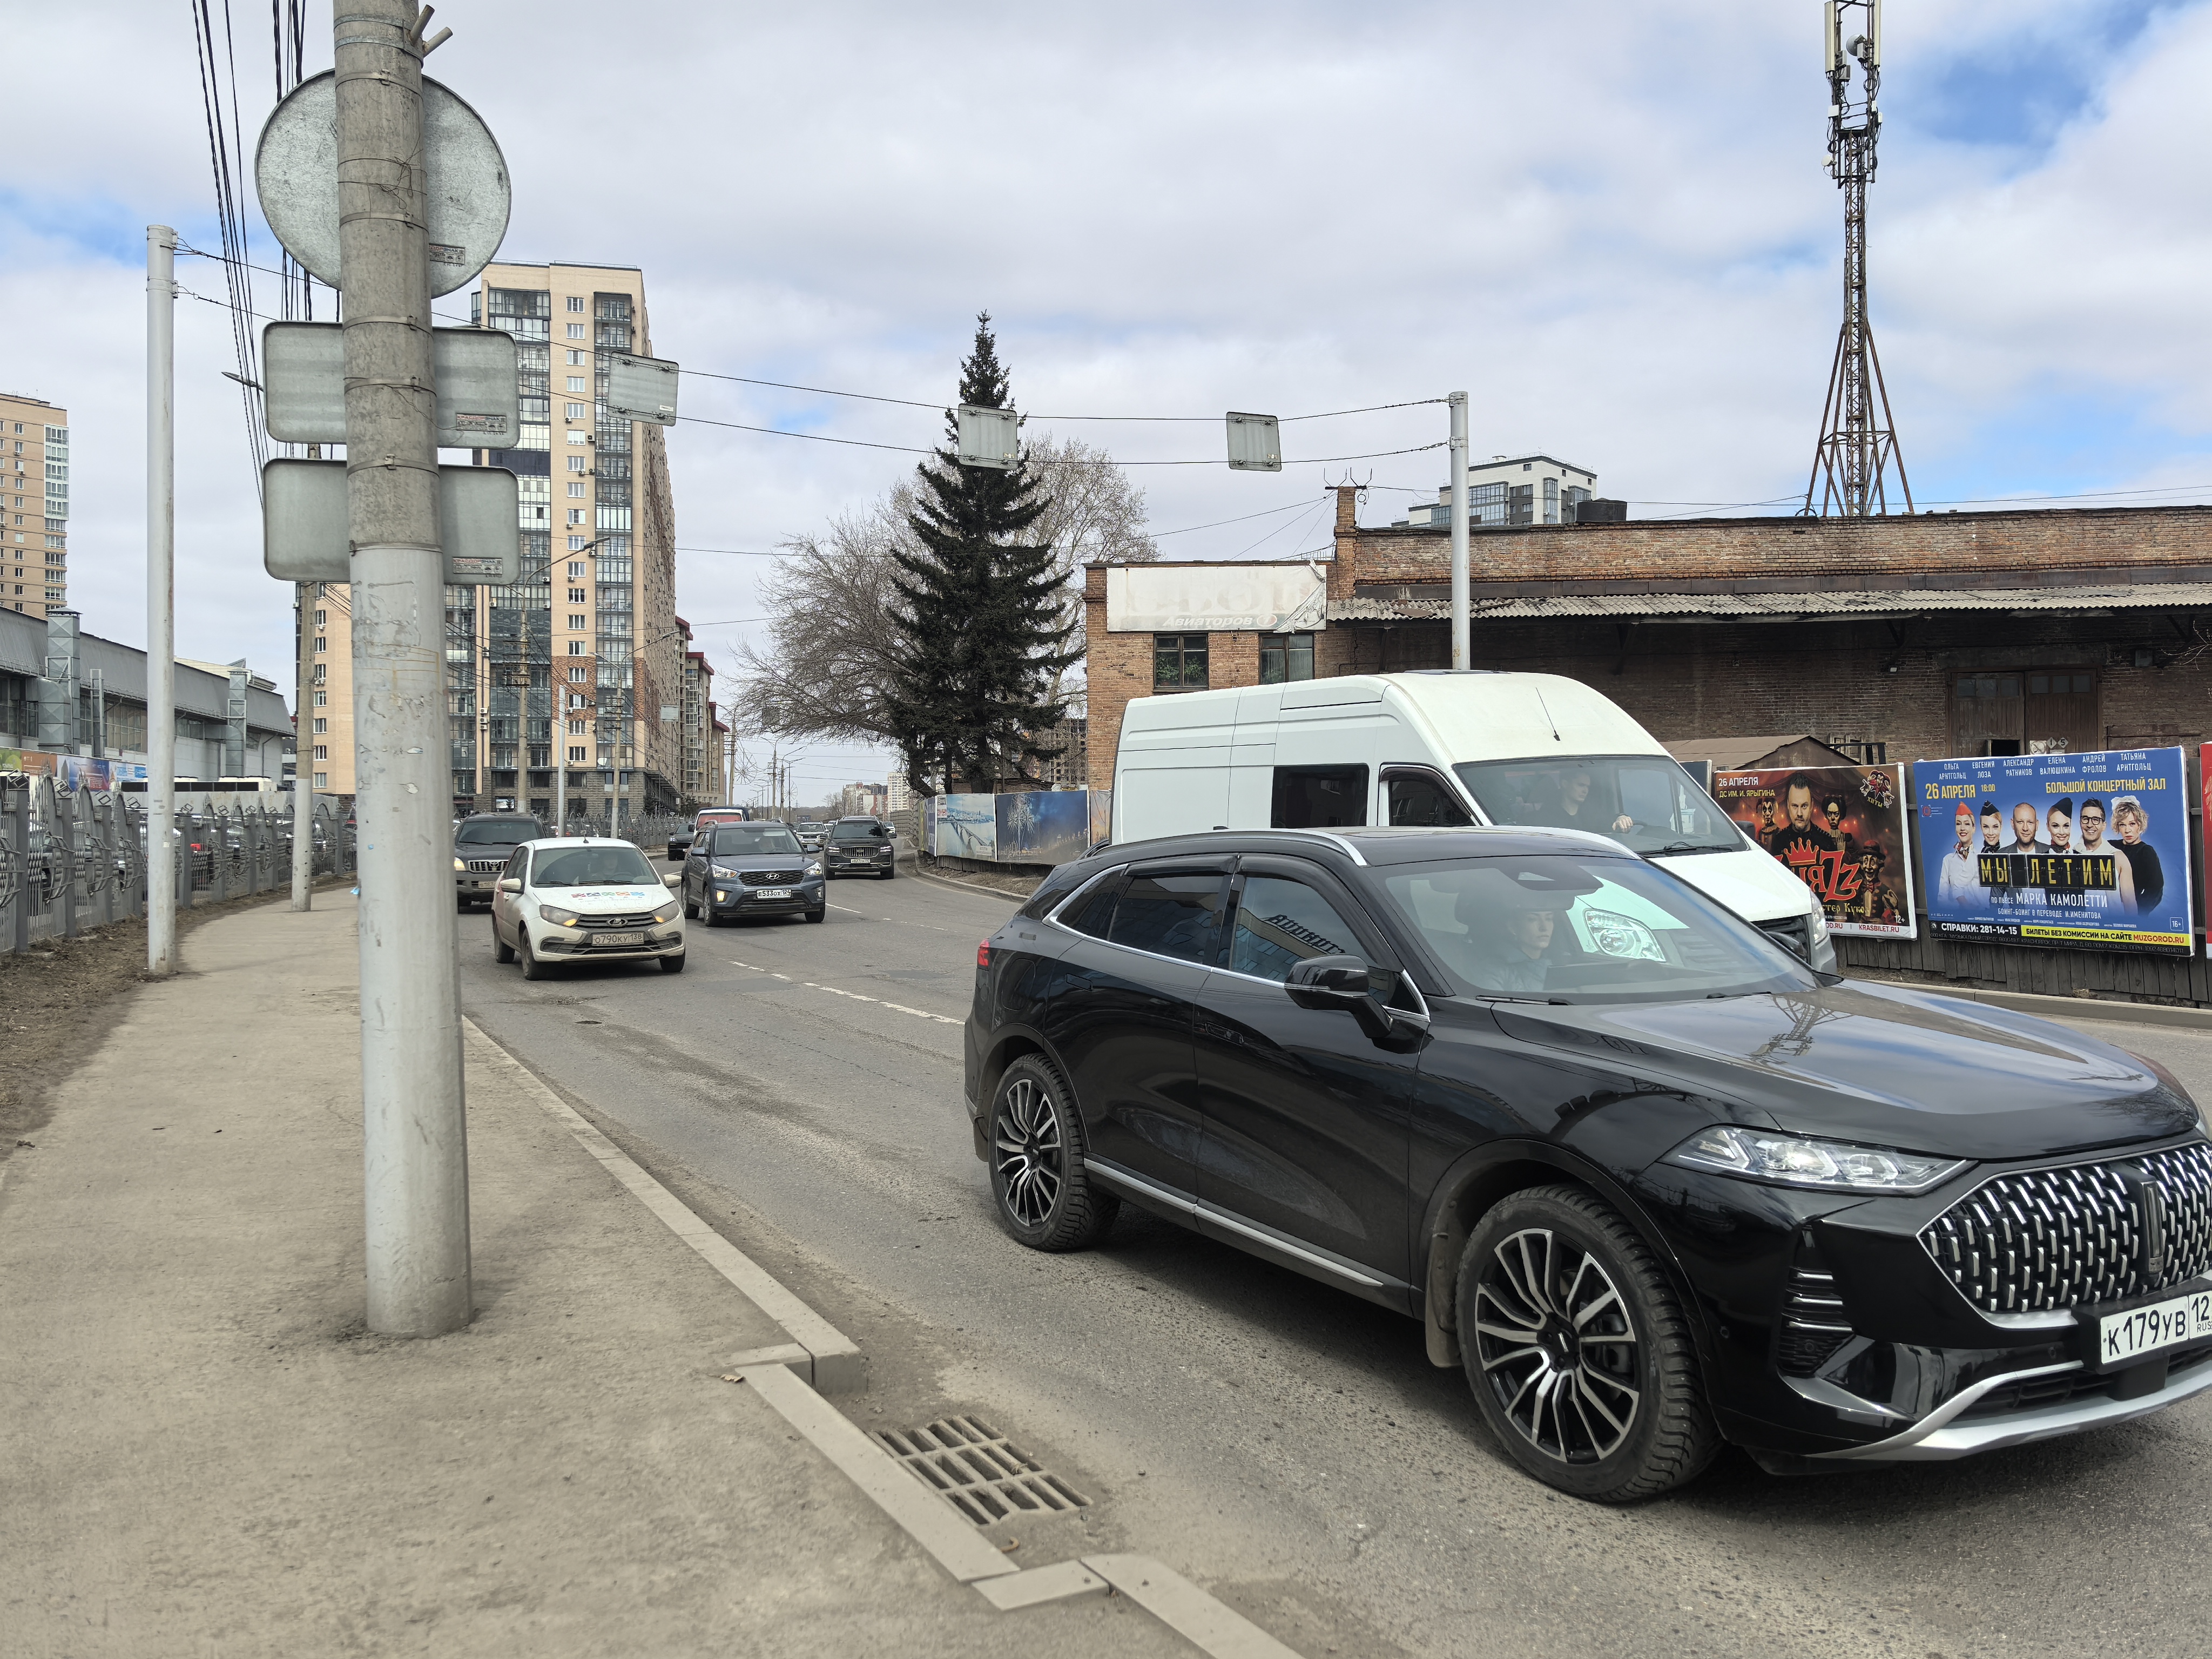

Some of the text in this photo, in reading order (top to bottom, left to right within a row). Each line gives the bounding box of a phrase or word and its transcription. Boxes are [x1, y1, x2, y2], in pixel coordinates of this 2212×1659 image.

[1163, 616, 1253, 628] Авиаторов
[2048, 756, 2066, 764] ЕЛЕНА
[2082, 754, 2105, 763] АНДРЕЙ
[2120, 752, 2146, 761] ТАТЬЯНА
[1972, 761, 1995, 769] ЕВГЕНИЯ
[2003, 758, 2034, 767] АЛЕКСАНДР
[2040, 766, 2075, 775] ВАЛЮШКИНА
[2082, 765, 2106, 773] ФРОЛОВ
[2116, 763, 2152, 772] АРНТГОЛЬЦ
[1939, 772, 1966, 780] АРНТГОЛЬЦ
[2006, 768, 2033, 777] РАТНИКОВ
[1718, 777, 1758, 786] 26 АПРЕЛЯ
[2046, 777, 2166, 793] БОЛЬШОЙ КОНЦЕРТНЫЙ ЗАЛ
[1925, 783, 1976, 799] 26 АПРЕЛЯ
[1981, 784, 1995, 792] 18:00
[1867, 797, 1883, 808] ХИТЫ
[1980, 858, 2113, 886] МЫ ЛЕТИМ
[2016, 893, 2047, 906] МАРКА
[2051, 893, 2108, 908] КАМОЛЕТТИ
[1998, 908, 2030, 916] БОИНГ-БОИНГ
[2037, 909, 2062, 918] ПЕРЕВОДЕ
[1894, 915, 1905, 923] 12+
[1858, 924, 1899, 932] KRASBILET.RU
[1941, 923, 2017, 935] СПРАВКИ: 281-14-15
[595, 935, 628, 943] О790КУ
[2062, 930, 2099, 939] КОМИССИИ
[2110, 932, 2132, 940] САЙТЕ
[2133, 934, 2184, 943] MUZGOROD.RU
[2108, 1295, 2210, 1357] К179УВ 12
[2197, 1321, 2211, 1333] RUS
